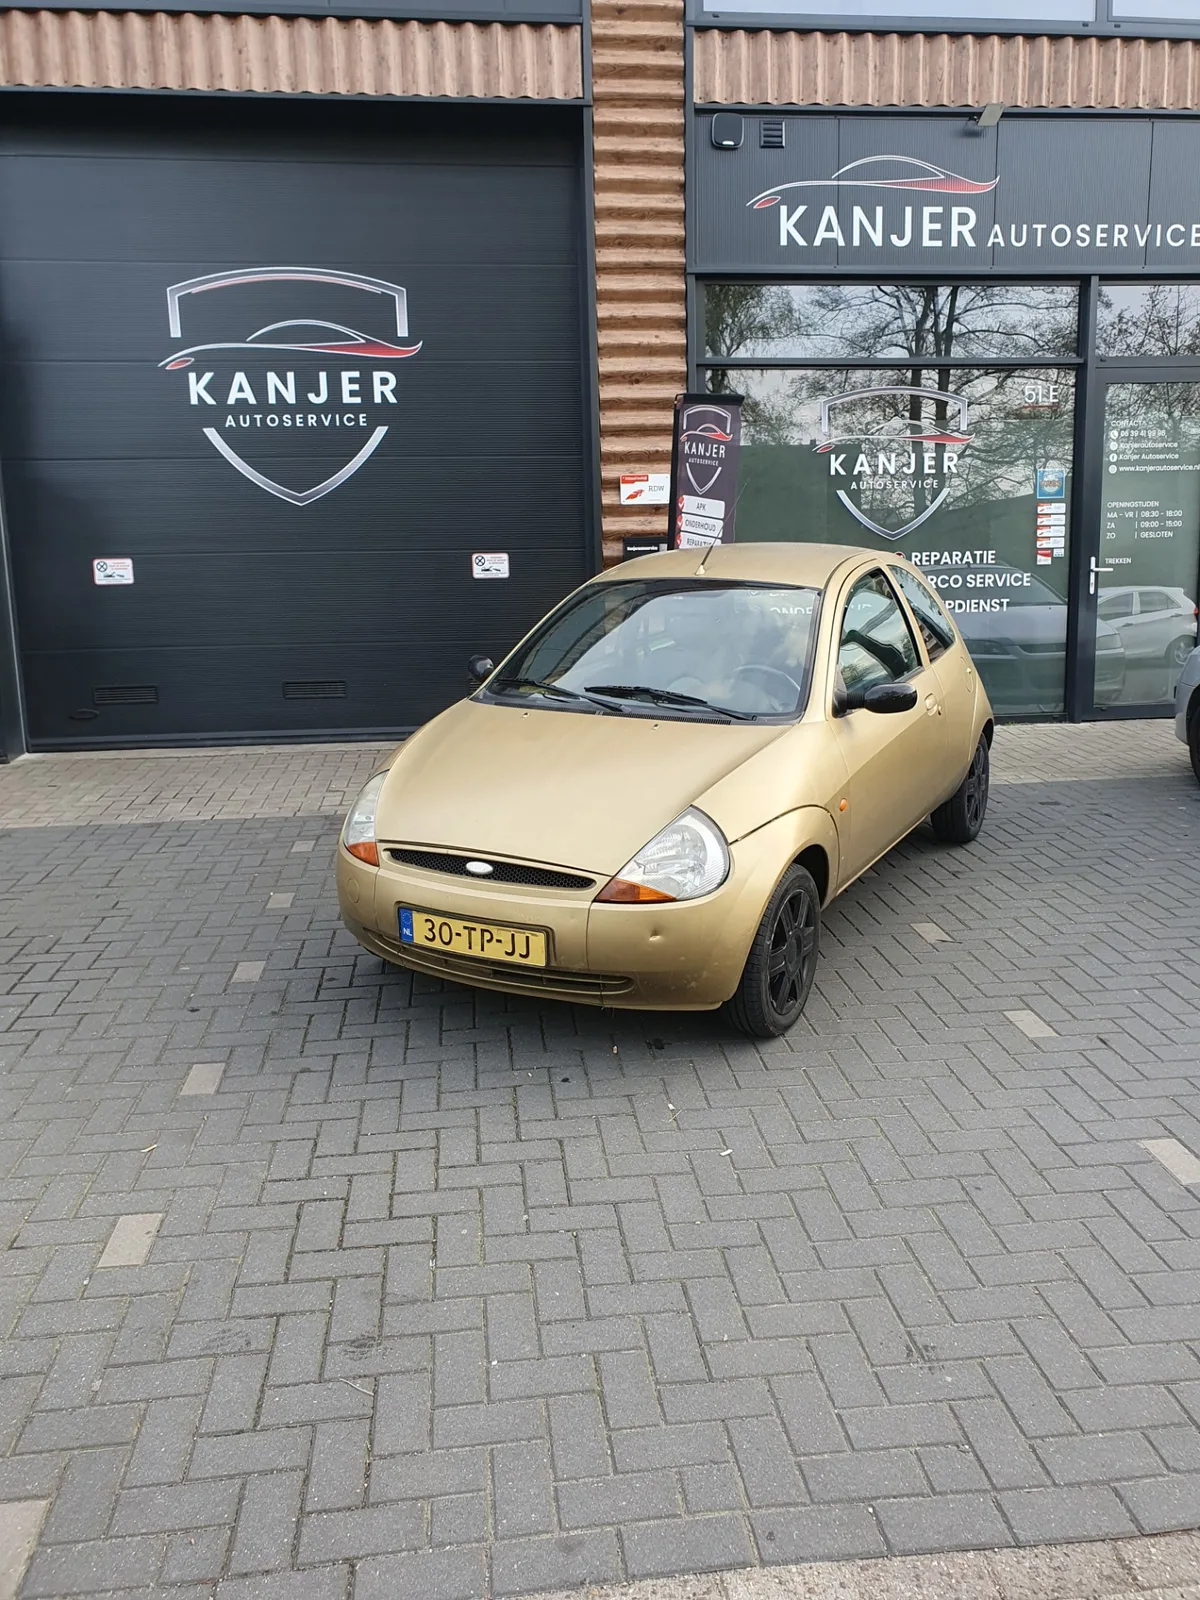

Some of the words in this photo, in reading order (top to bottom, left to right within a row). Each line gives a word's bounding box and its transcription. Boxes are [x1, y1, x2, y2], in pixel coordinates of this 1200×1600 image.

[779, 205, 977, 247] KANJER
[987, 223, 1200, 247] AUTOSERVICE
[188, 371, 398, 405] KANJER
[225, 413, 368, 428] AUTOSERVICE
[684, 441, 726, 458] KANJER
[829, 452, 959, 476] KANJER
[648, 485, 665, 493] RDW
[850, 479, 939, 490] AUTOSERVICE
[696, 502, 706, 512] APK
[1106, 500, 1160, 508] OPENINGSTIJDEN
[1140, 510, 1160, 518] 08:30
[1165, 509, 1183, 517] 18:00
[685, 519, 716, 532] ONDERHOUD
[1140, 520, 1160, 528] 09:00
[1165, 520, 1183, 528] 15:00
[1106, 532, 1116, 540] ZO
[1140, 530, 1174, 539] GESLOTEN
[911, 550, 996, 566] REPARATIE
[927, 574, 962, 589] RCO
[966, 572, 1031, 588] SERVICE
[942, 598, 1010, 613] PDIENST
[403, 927, 412, 936] NL
[424, 917, 531, 959] 30-TP-JJ
